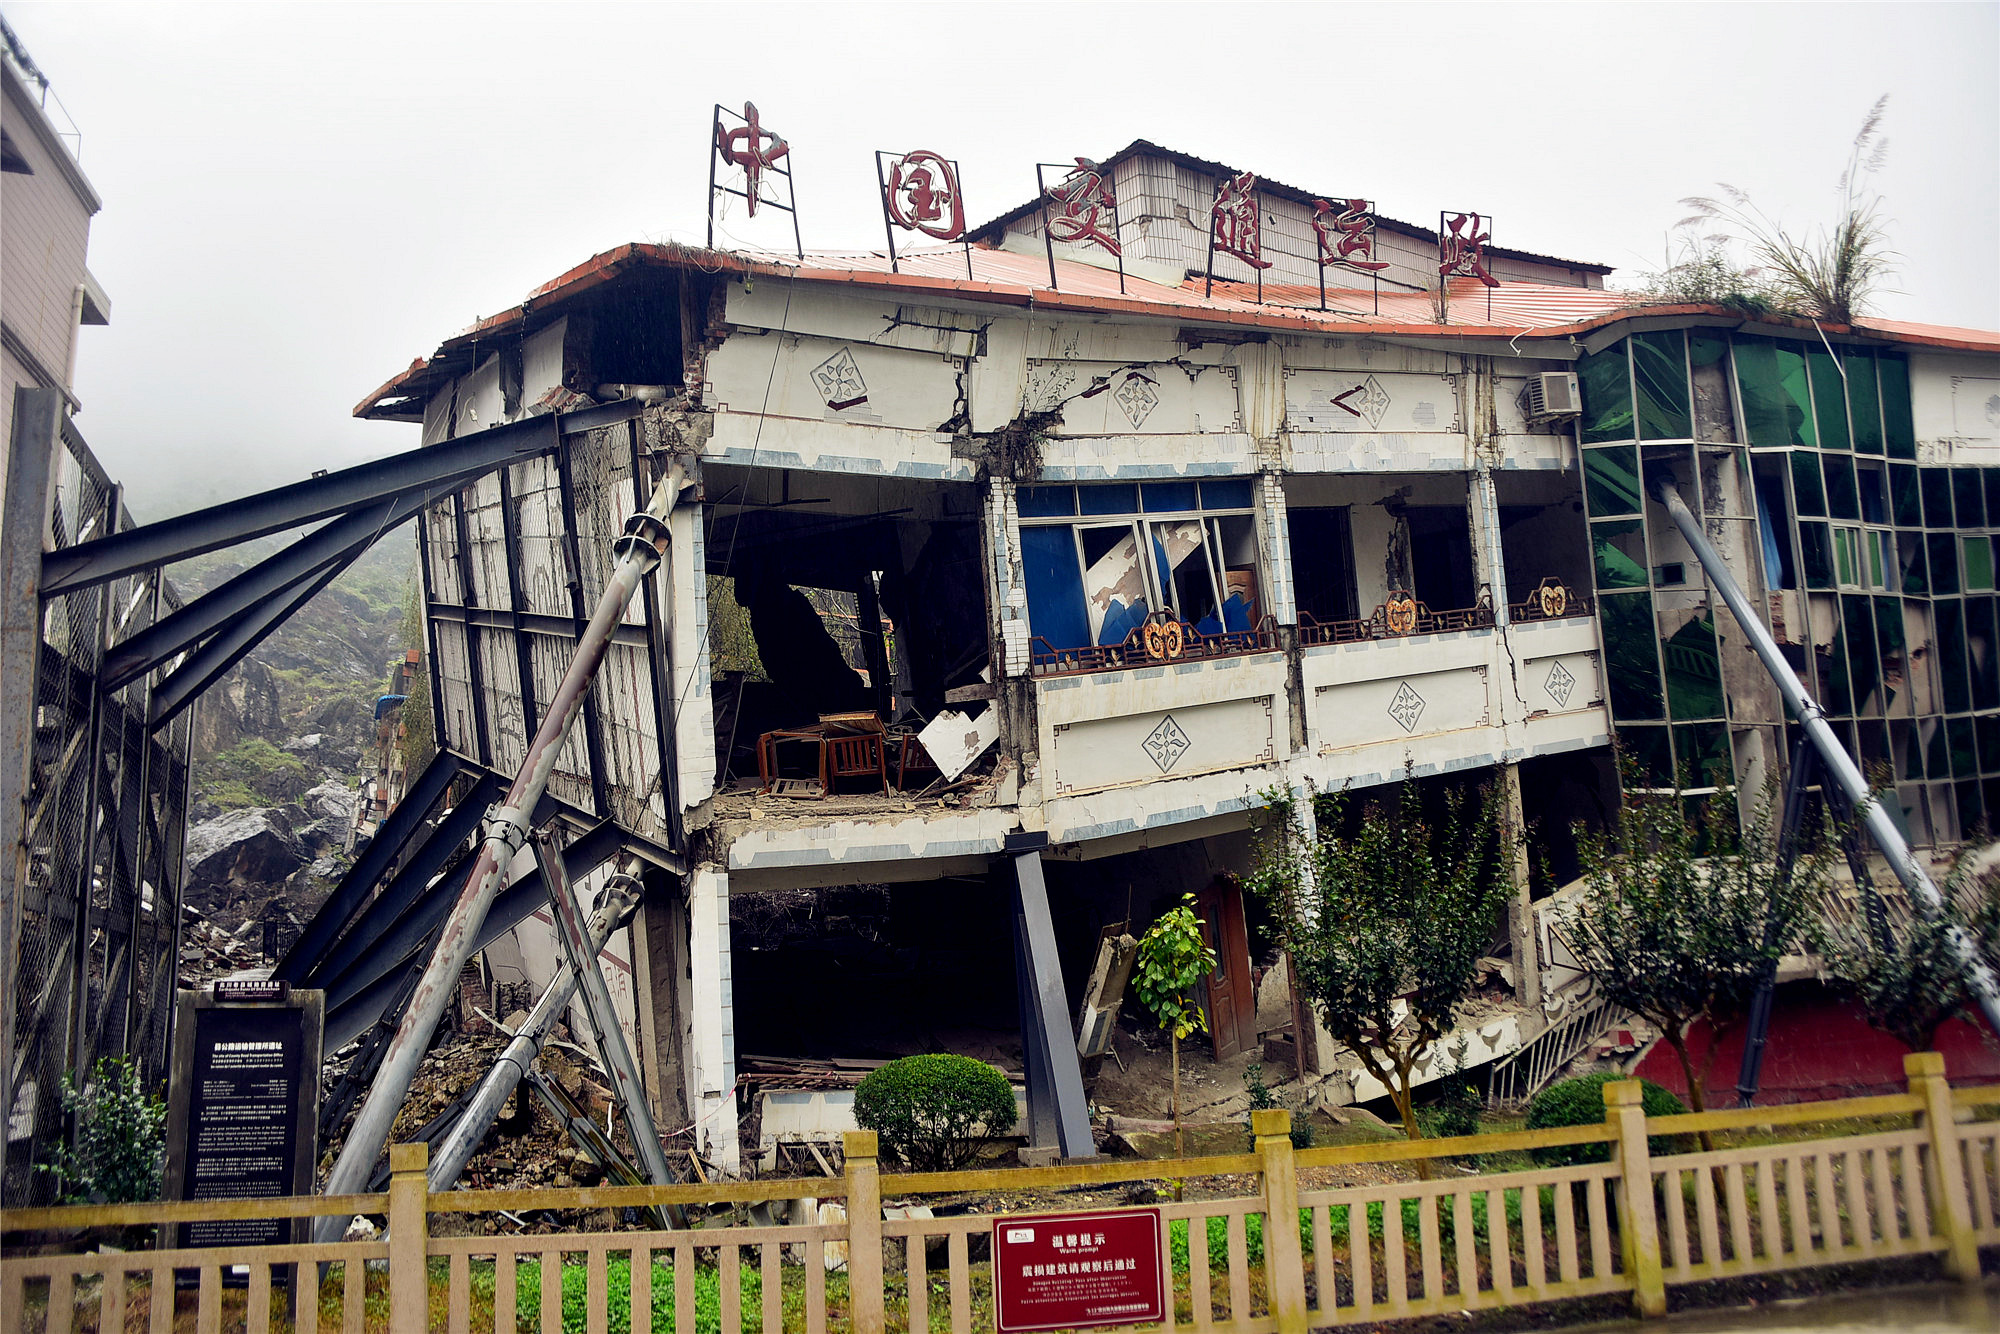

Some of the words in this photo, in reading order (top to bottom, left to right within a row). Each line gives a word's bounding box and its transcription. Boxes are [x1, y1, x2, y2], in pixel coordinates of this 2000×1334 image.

[1052, 1232, 1106, 1248] 温馨提示
[1078, 1246, 1099, 1255] prompt
[1022, 1257, 1137, 1278] 震损建筑请观察后通过
